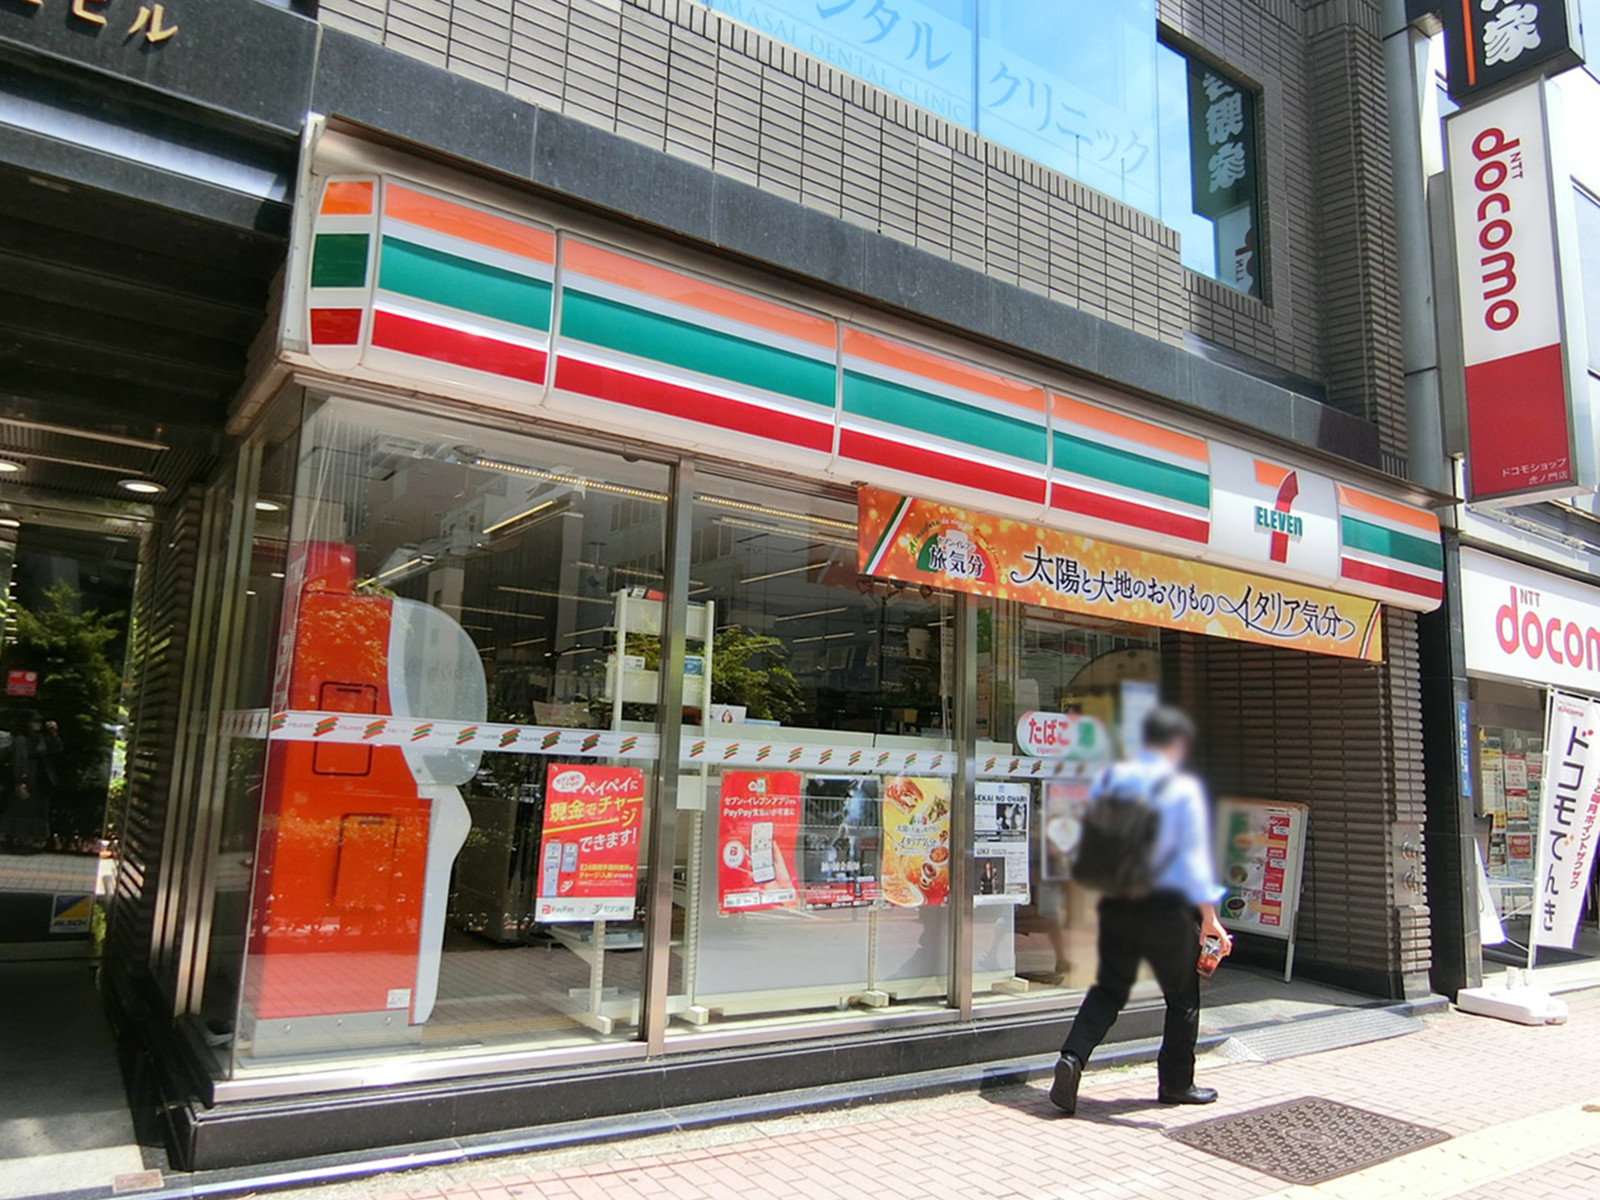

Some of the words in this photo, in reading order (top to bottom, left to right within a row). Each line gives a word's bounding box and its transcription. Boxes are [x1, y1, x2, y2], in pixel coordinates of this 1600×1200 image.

[809, 34, 890, 88] DENTAL
[898, 77, 967, 122] CLINIC
[1509, 151, 1523, 180] NTT
[1471, 127, 1520, 331] docomo
[1253, 458, 1299, 564] 7
[929, 546, 984, 577] 旅気分
[1010, 546, 1215, 619] 太陽と大地のおくりもの
[1218, 585, 1357, 641] イタリア気分
[1520, 588, 1540, 608] NTT
[1028, 717, 1070, 747] たばこ
[581, 776, 638, 796] ペイペイに
[1544, 725, 1594, 932] ドコモでんき
